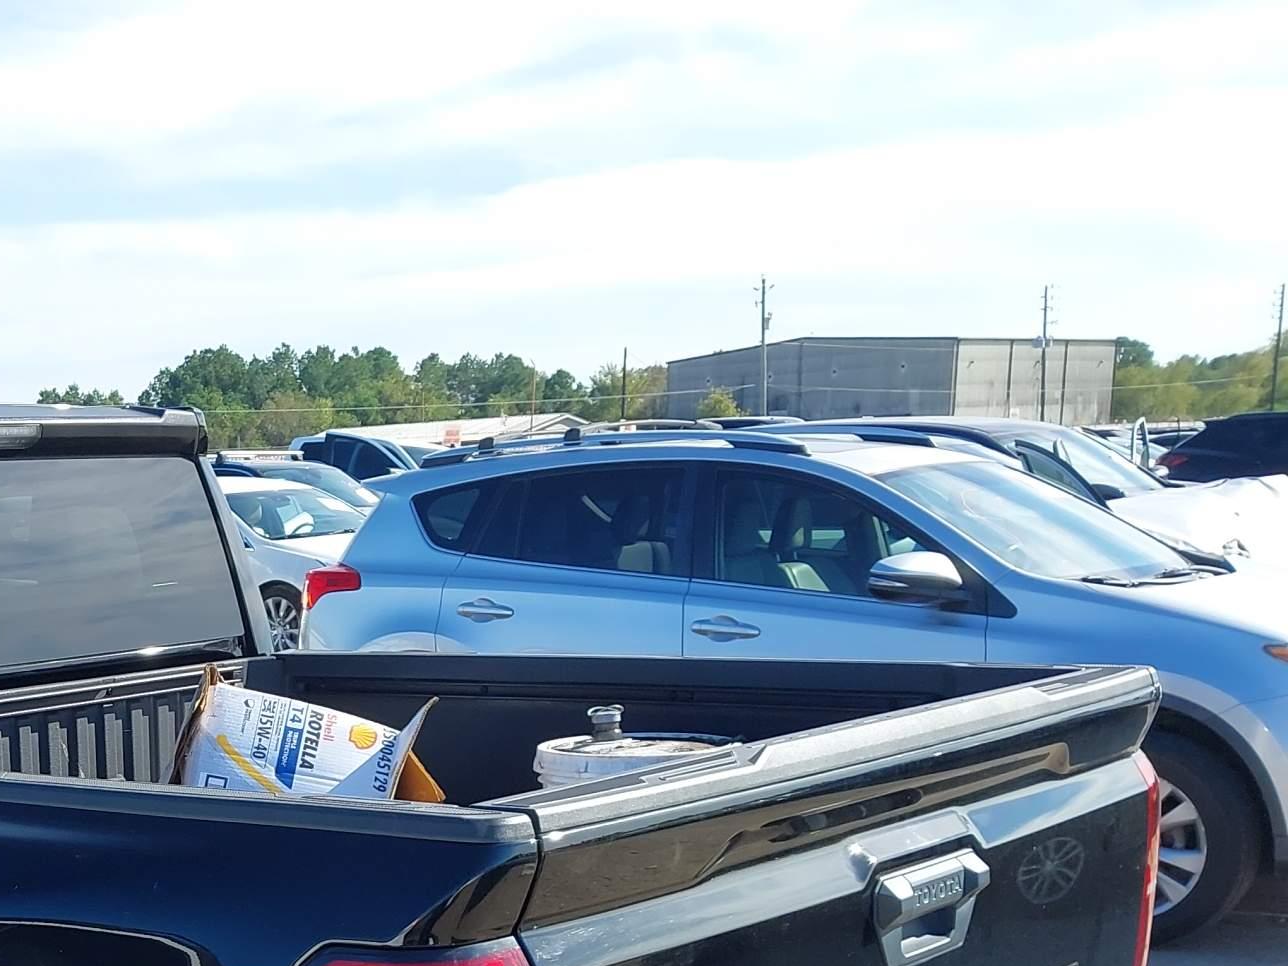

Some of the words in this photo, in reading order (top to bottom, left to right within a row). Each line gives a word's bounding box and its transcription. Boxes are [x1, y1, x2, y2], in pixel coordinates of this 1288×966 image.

[262, 699, 277, 714] SAE
[289, 707, 305, 724] T4
[252, 713, 275, 760] 15W-40
[299, 708, 325, 770] ROTELLA
[323, 713, 338, 742] Shell
[913, 874, 963, 907] TOYOTA
